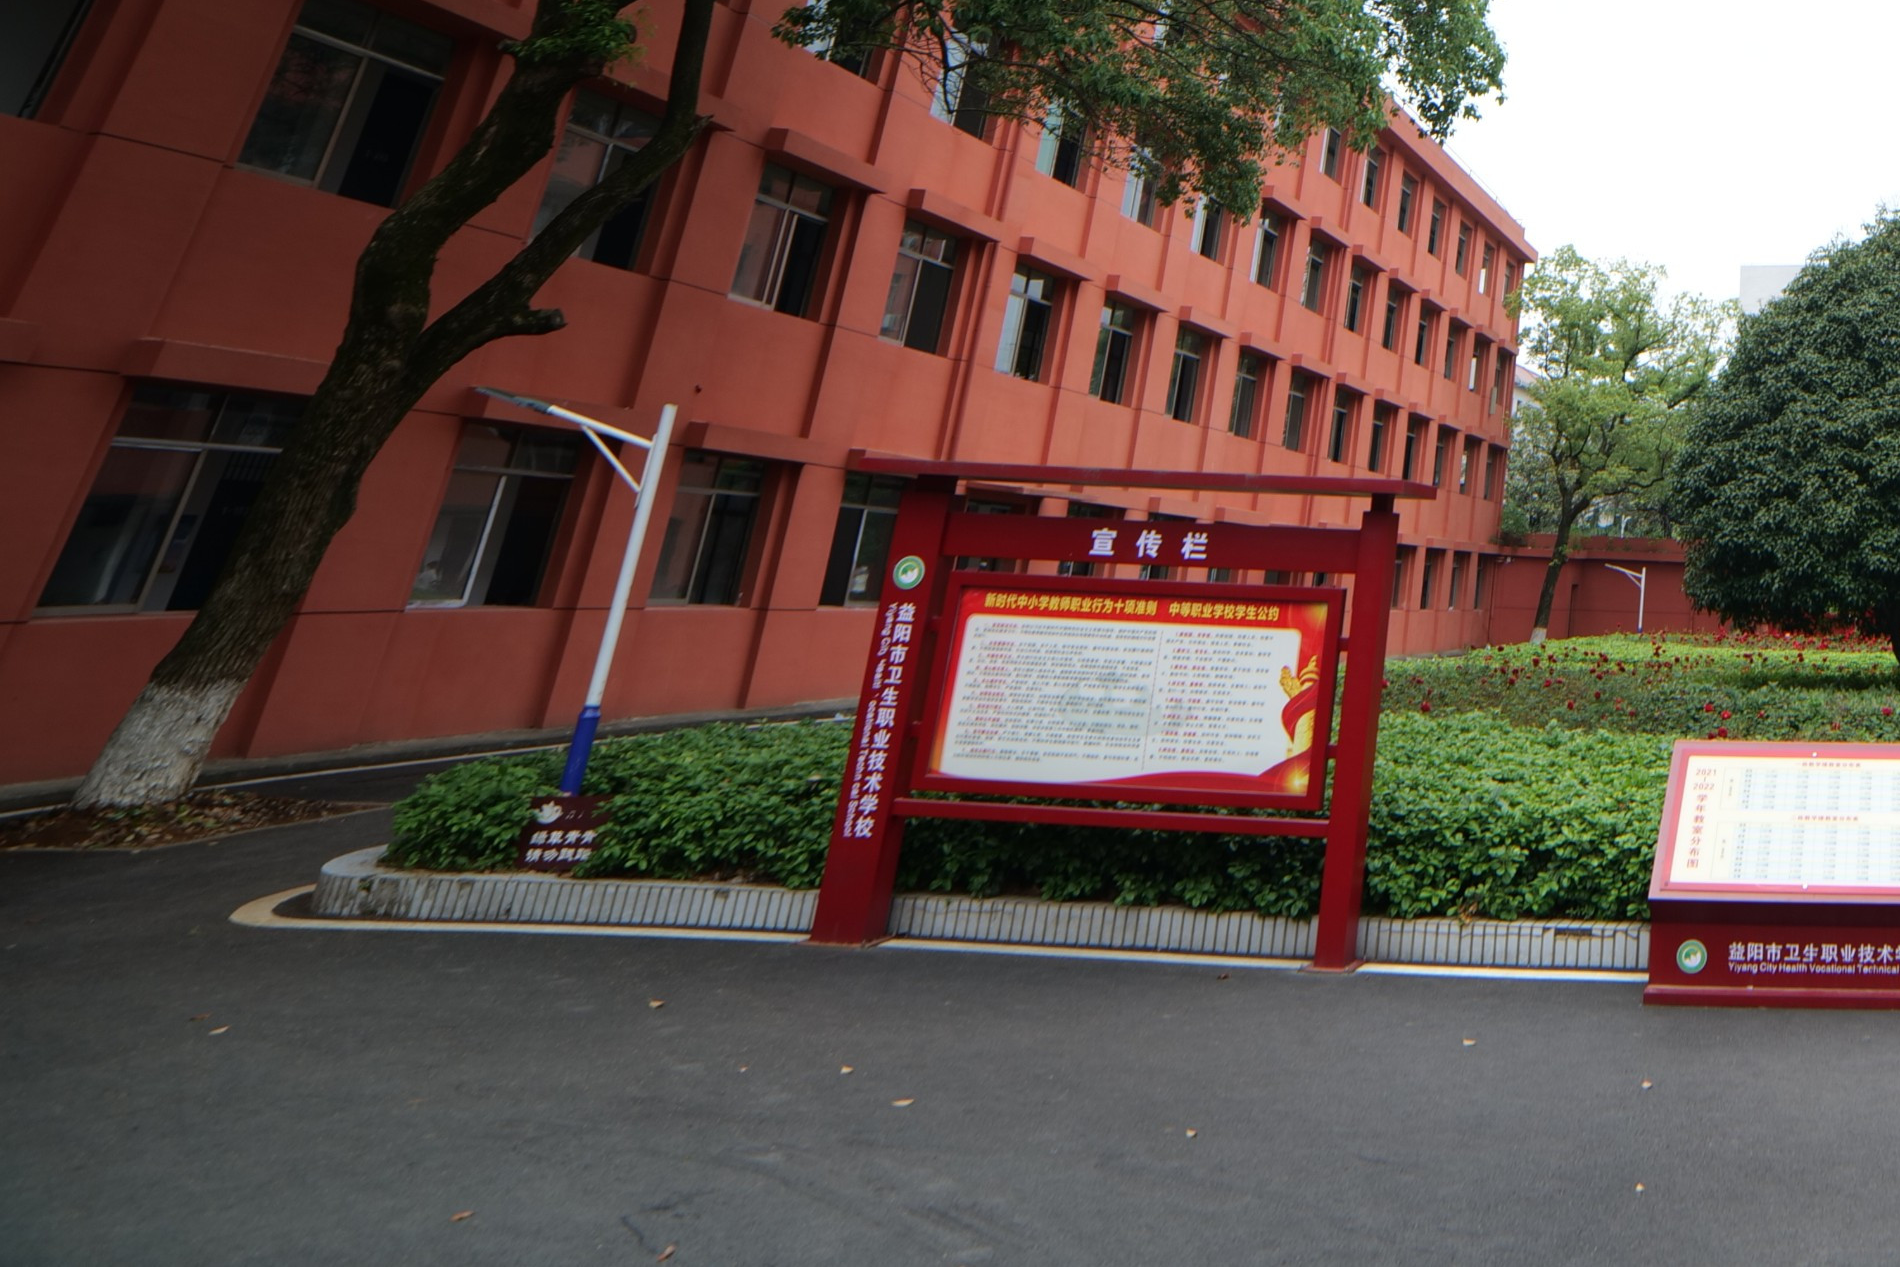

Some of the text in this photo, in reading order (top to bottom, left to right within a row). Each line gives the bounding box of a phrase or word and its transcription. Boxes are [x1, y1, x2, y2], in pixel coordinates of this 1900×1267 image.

[1089, 528, 1208, 560] 宣传栏
[984, 592, 1280, 622] 新时代中小学教师职业行为十项准则 中等职业学校学生公约
[853, 602, 917, 838] 益阳市卫生职业技术学校
[1728, 962, 1758, 974] Yiyang
[1759, 962, 1778, 974] City
[1779, 963, 1808, 973] Health
[1810, 963, 1855, 974] Vocational
[1857, 964, 1900, 975] Technical
